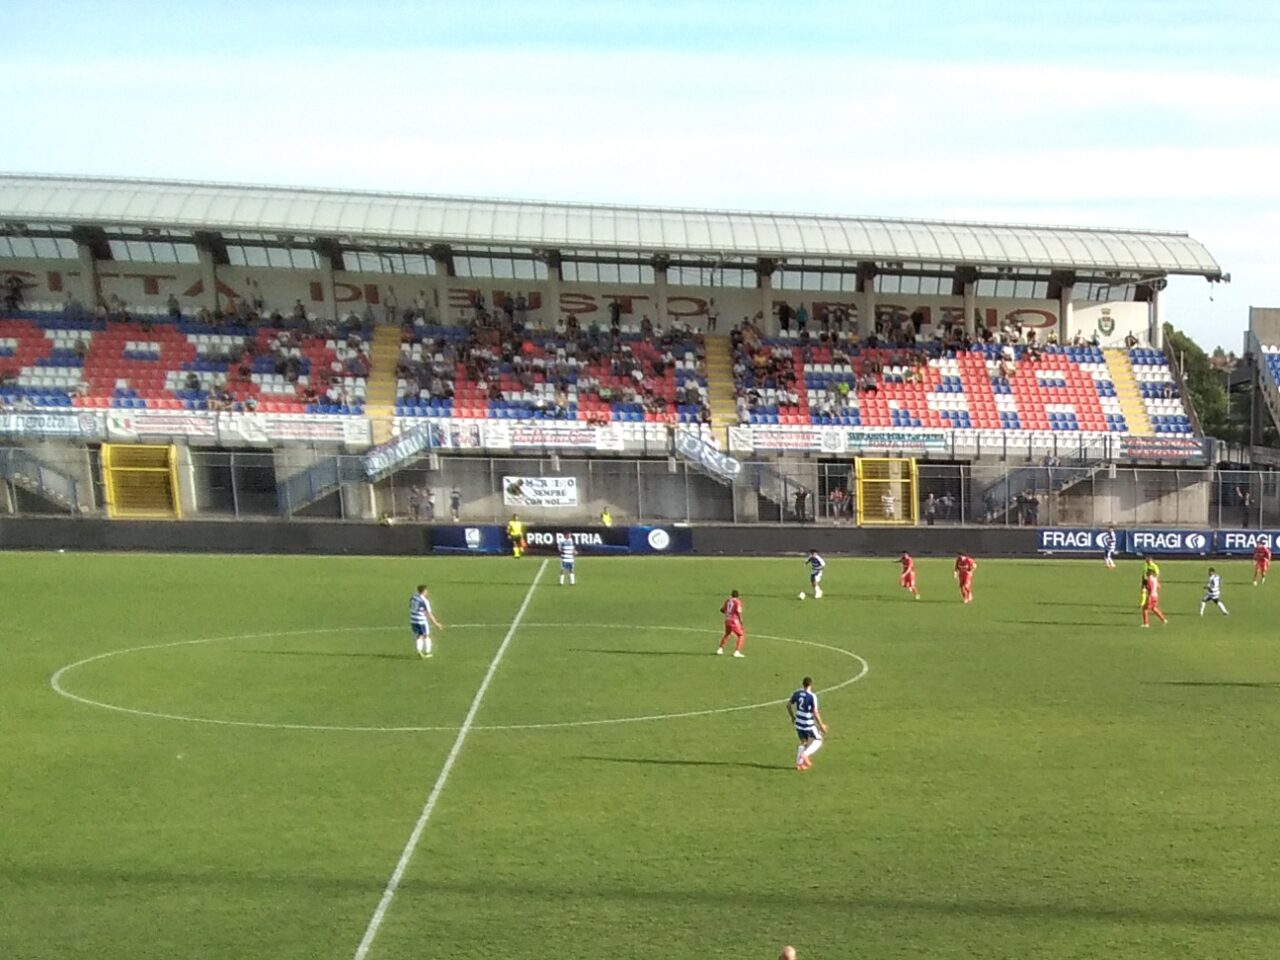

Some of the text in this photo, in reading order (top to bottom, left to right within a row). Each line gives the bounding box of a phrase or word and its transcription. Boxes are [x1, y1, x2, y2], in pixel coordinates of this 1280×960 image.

[526, 532, 553, 545] PRO
[1043, 531, 1091, 547] FRAGI
[1133, 532, 1181, 548] FRAGI
[1225, 533, 1272, 549] FRAGI
